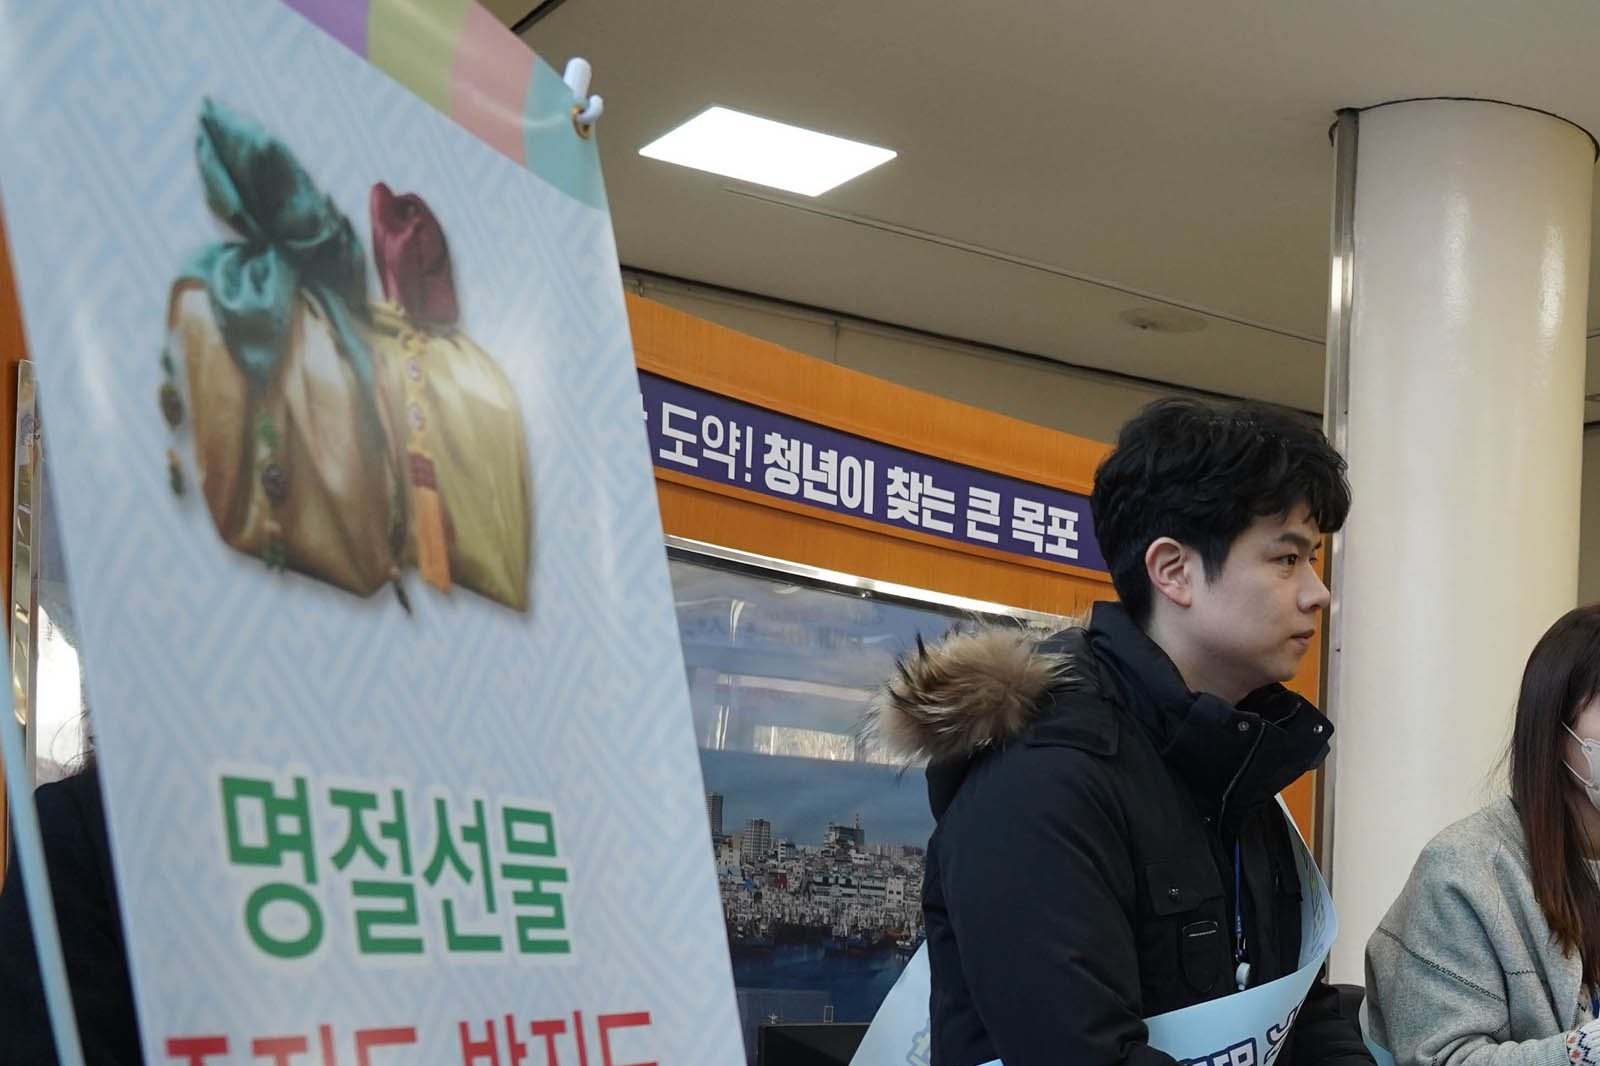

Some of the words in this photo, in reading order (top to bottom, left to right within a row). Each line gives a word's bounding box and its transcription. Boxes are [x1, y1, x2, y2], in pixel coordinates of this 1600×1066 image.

[659, 401, 754, 484] 도약!
[764, 430, 874, 515] 청년이
[886, 466, 956, 534] 찾는
[966, 485, 1001, 544] 큰
[1011, 497, 1079, 560] 목포
[218, 773, 572, 960] 명절선물
